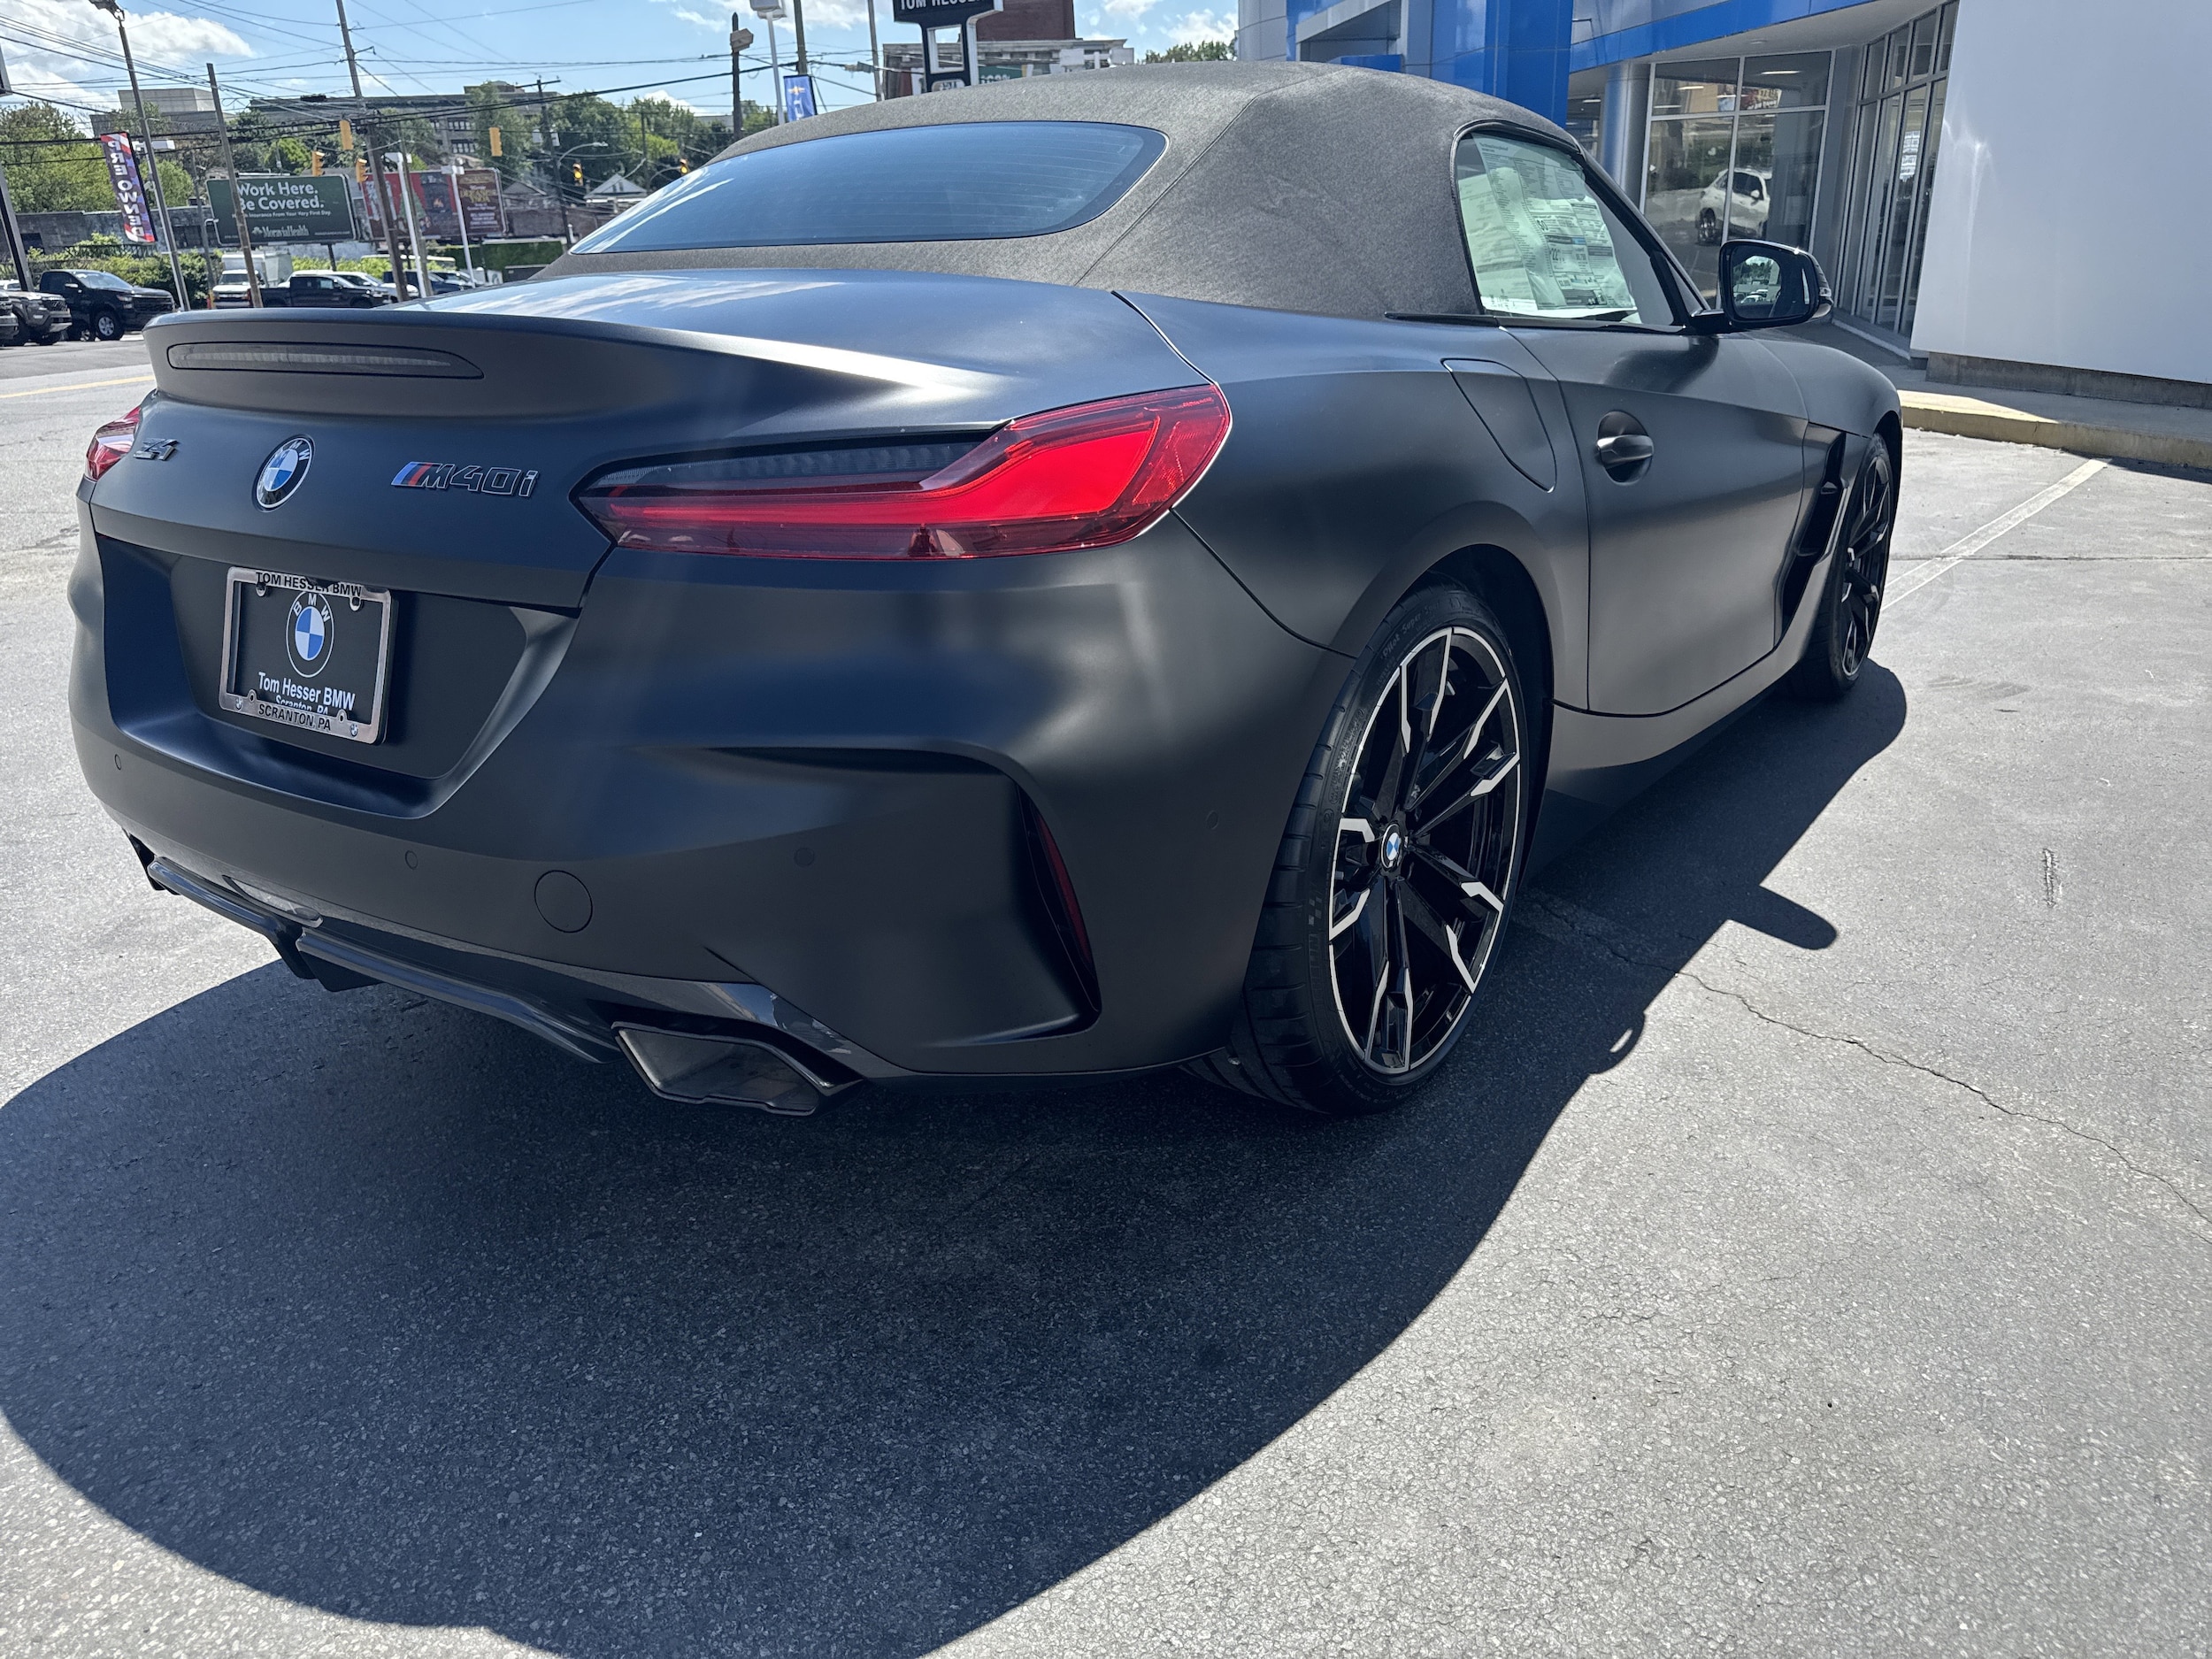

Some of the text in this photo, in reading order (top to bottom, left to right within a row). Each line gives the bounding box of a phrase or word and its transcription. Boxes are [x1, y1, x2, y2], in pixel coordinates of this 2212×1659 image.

[236, 181, 319, 196] Work Here.
[240, 195, 325, 211] Be Covered.
[133, 437, 180, 461] Z4
[256, 572, 281, 586] TOM
[333, 582, 362, 597] BMW
[293, 592, 331, 623] BMW
[258, 672, 356, 711] Tom Hesser BMW
[318, 717, 332, 731] PA
